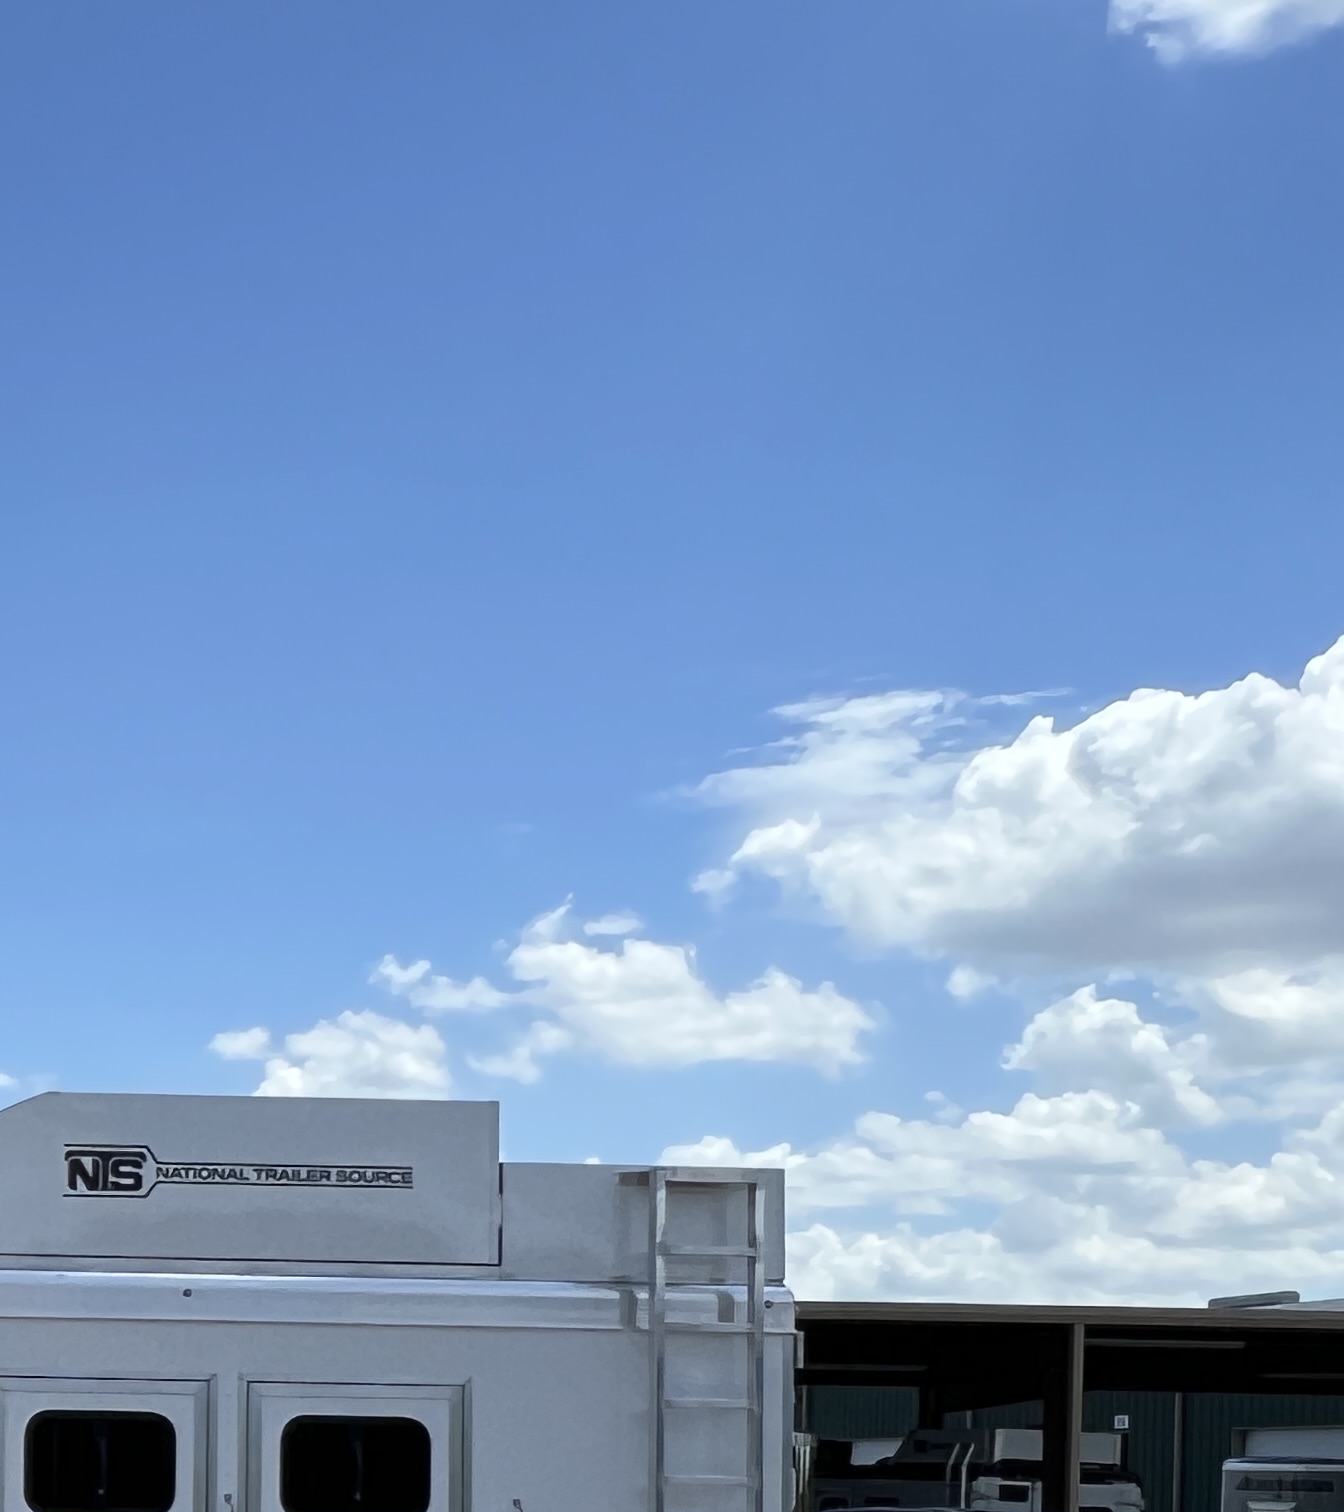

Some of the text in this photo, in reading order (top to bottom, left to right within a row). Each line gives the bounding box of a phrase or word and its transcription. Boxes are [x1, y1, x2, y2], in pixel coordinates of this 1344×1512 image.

[65, 1150, 413, 1191] NTS NATIONAL TRAILER SOURCE
